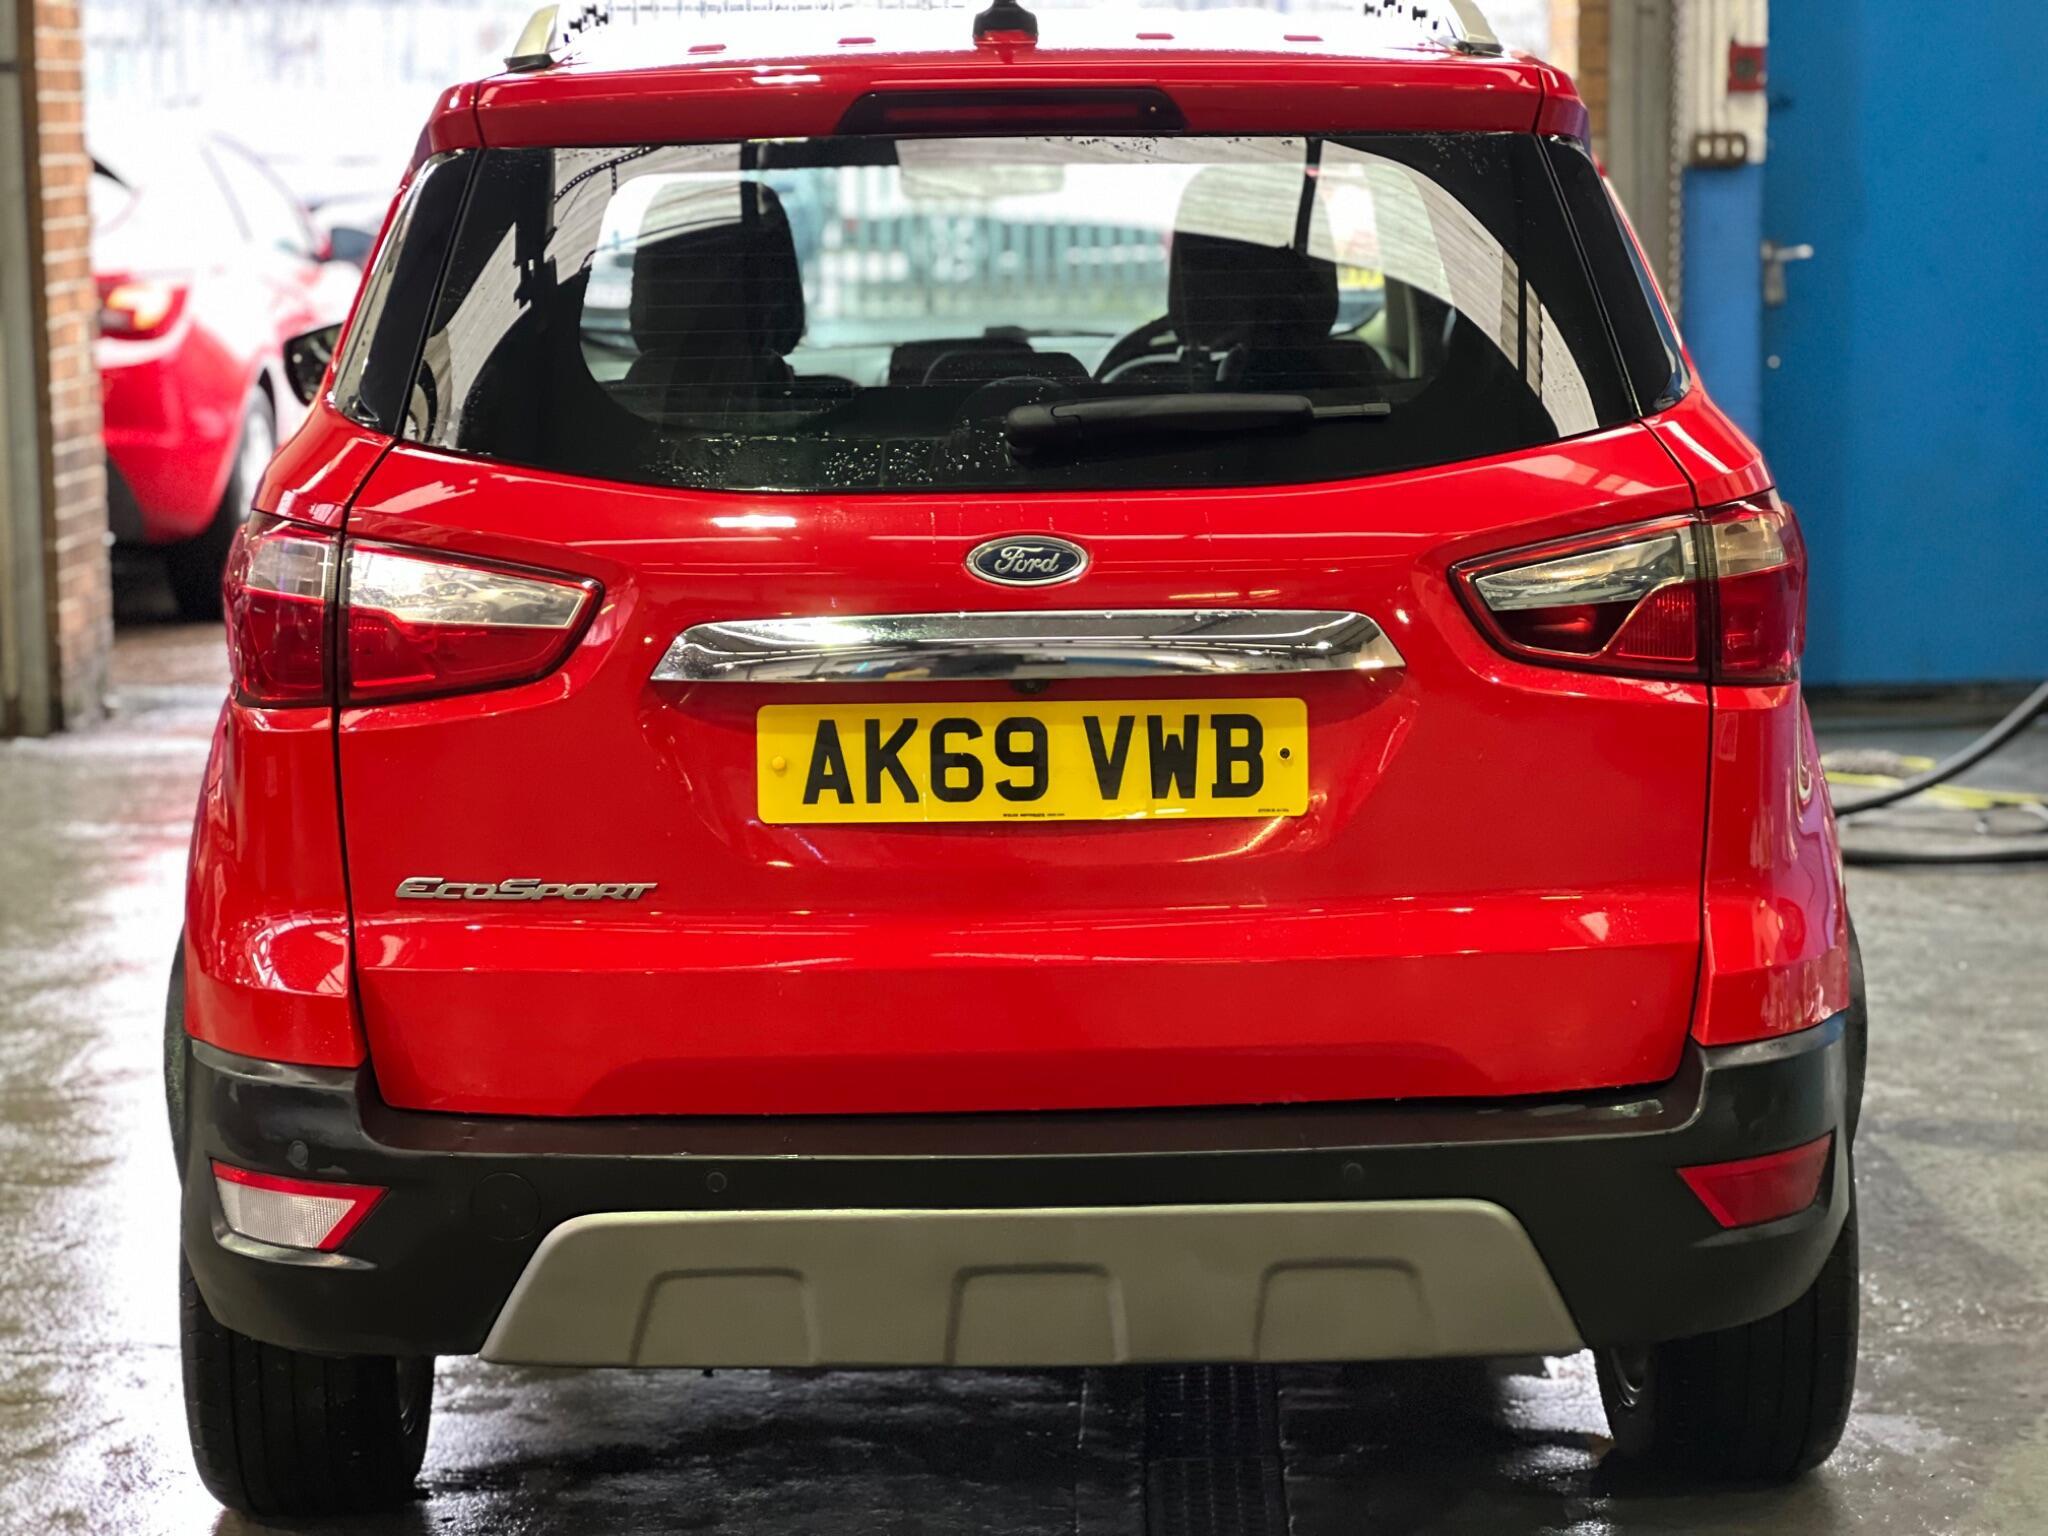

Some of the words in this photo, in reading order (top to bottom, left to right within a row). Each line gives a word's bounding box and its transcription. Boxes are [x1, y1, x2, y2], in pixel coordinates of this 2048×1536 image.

[994, 546, 1060, 573] Ford
[802, 717, 1049, 805] AK69
[1083, 713, 1265, 801] VWB
